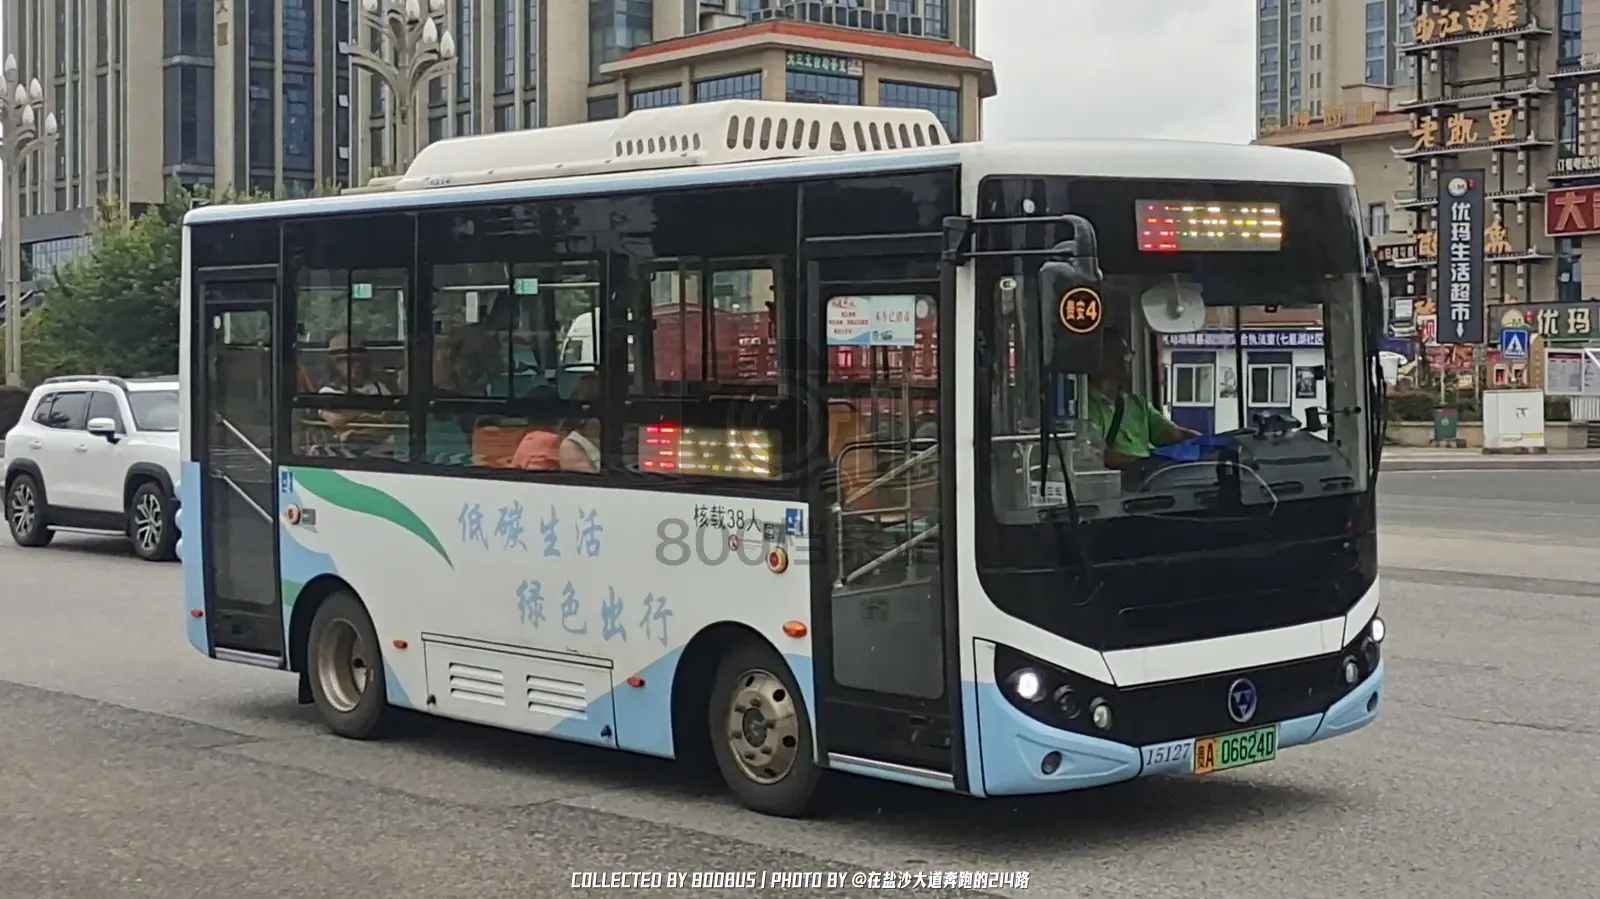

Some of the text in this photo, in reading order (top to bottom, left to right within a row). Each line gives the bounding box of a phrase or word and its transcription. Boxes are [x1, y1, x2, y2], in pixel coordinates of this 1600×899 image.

[1408, 109, 1515, 151] 老凯里
[1451, 202, 1471, 321] 优玛生活超市
[458, 500, 603, 557] 低碳生活
[694, 504, 761, 532] 核载38人
[516, 580, 673, 648] 绿色出行
[1145, 742, 1191, 766] 15127
